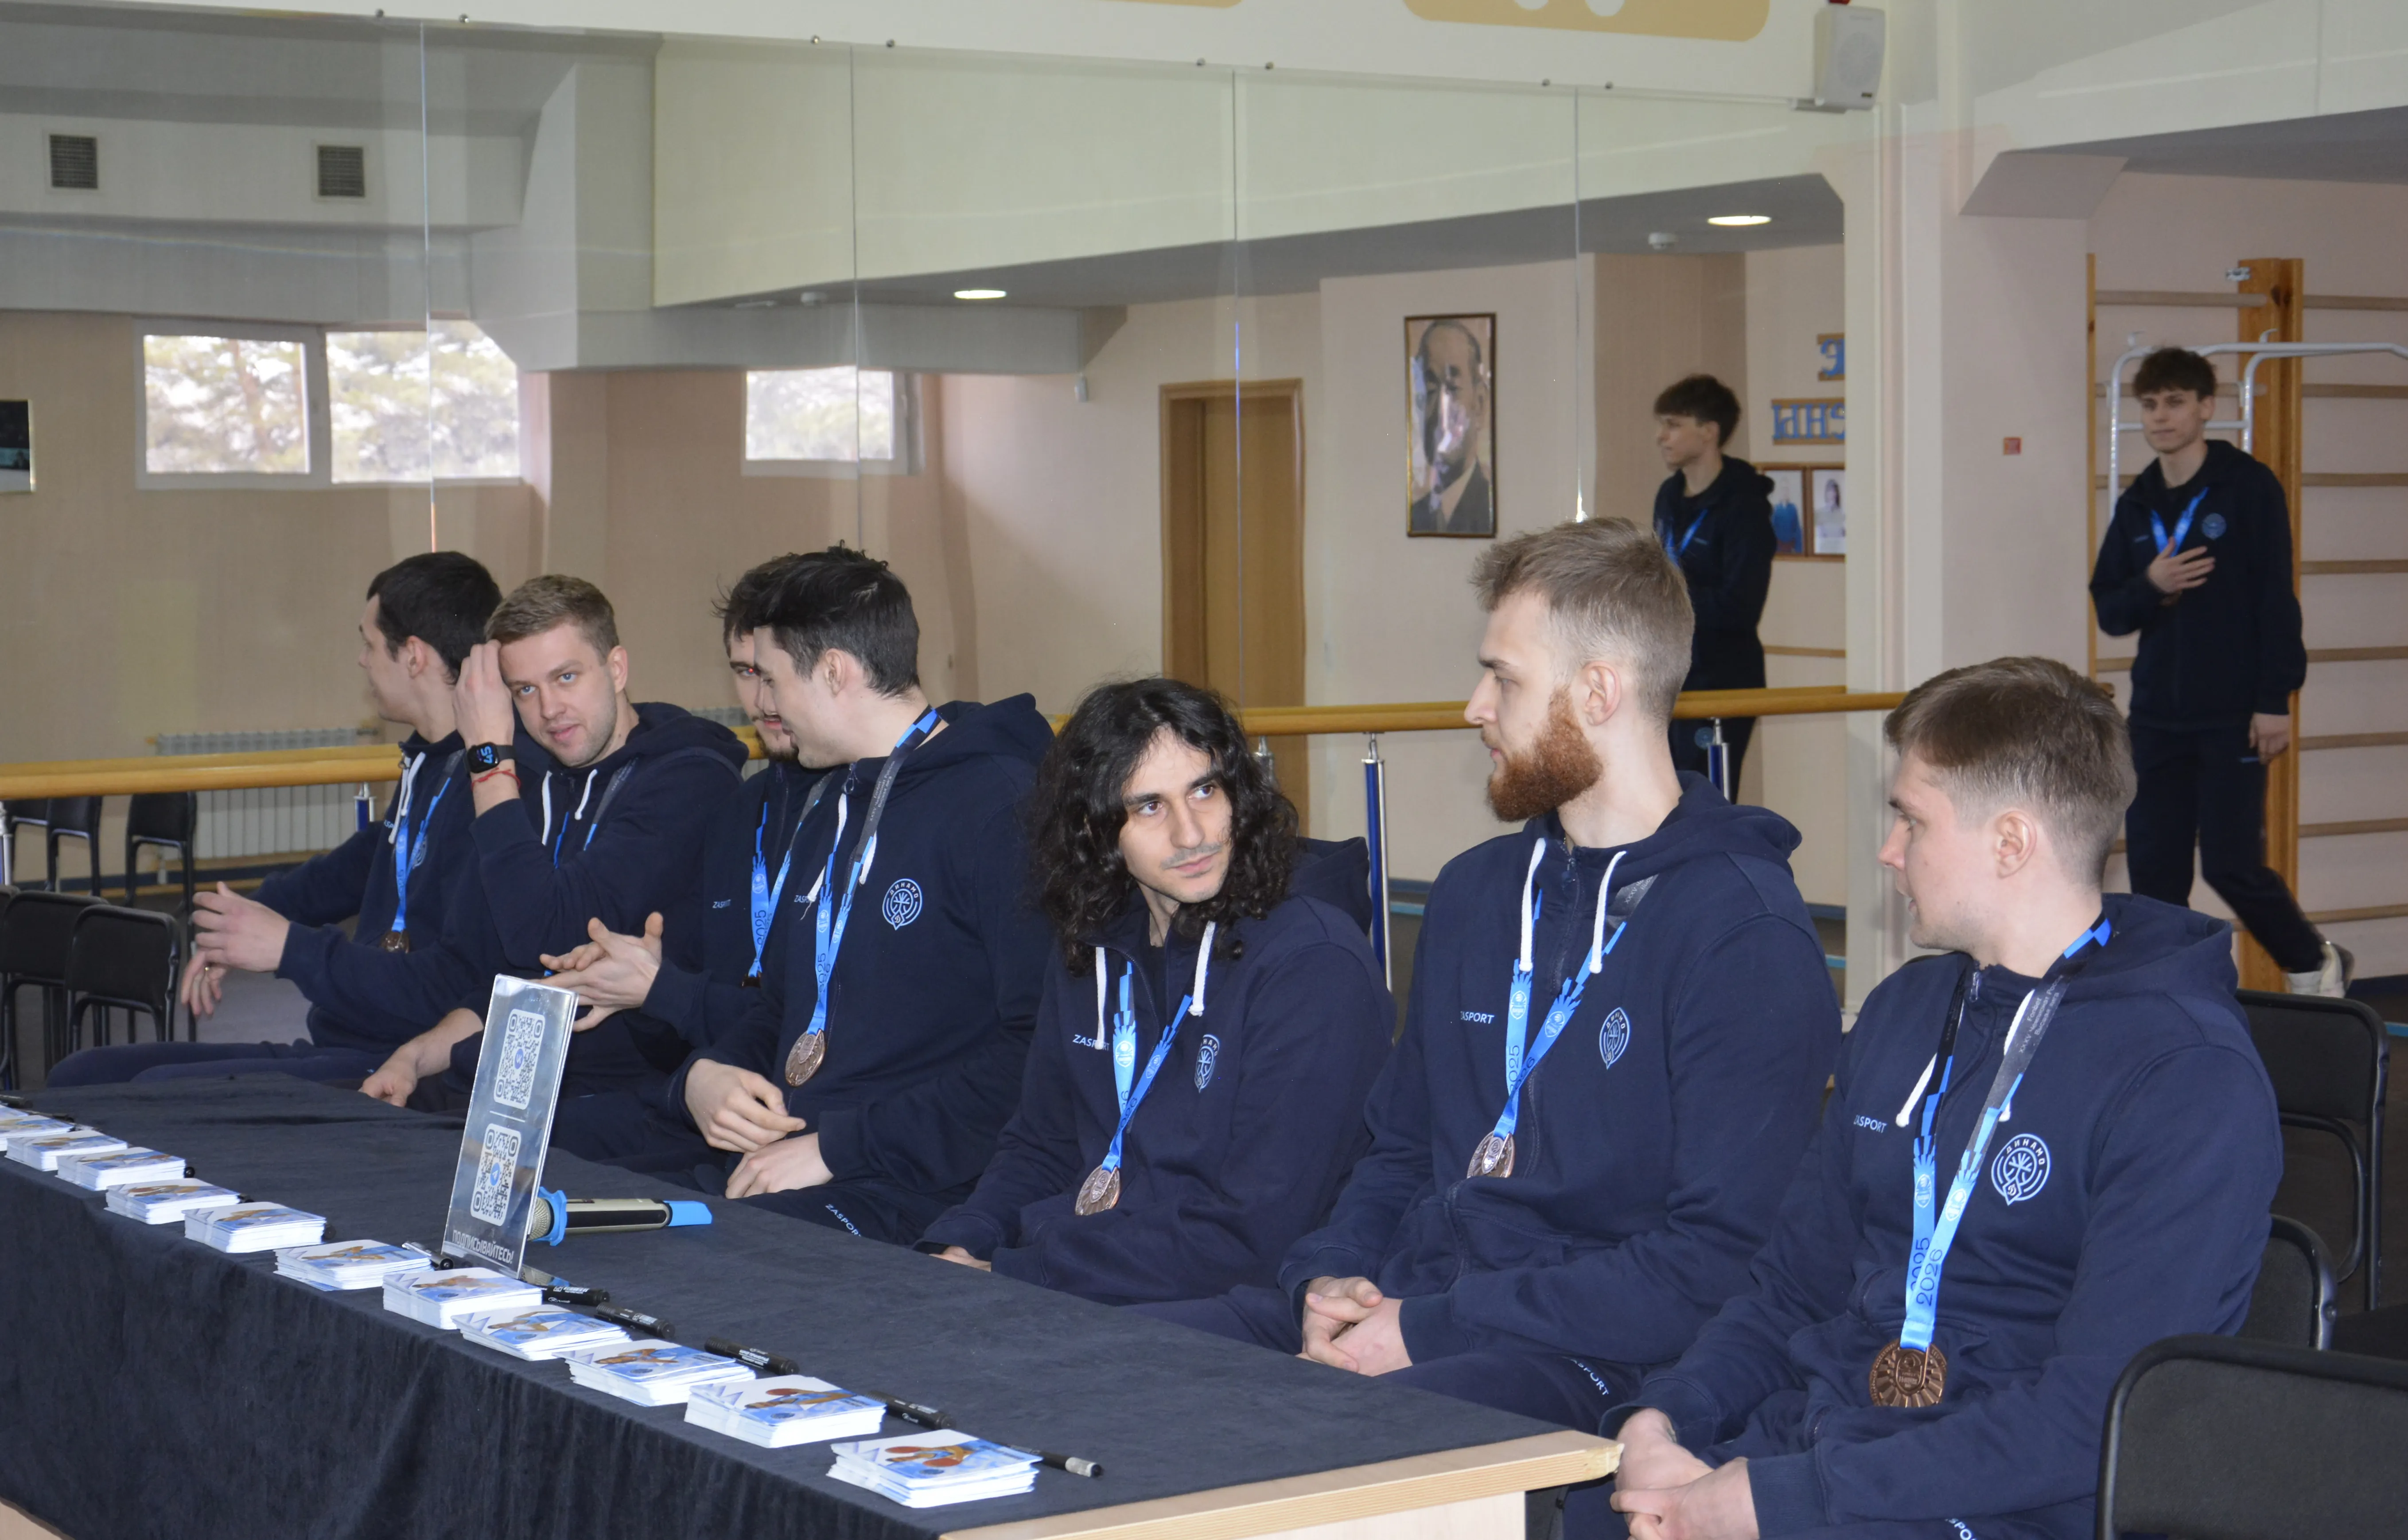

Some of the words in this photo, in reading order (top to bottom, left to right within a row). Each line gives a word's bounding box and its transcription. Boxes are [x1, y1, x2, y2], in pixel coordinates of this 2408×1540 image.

[890, 882, 919, 898] ДИНАМО
[1072, 1034, 1110, 1052] ZASPRT
[1203, 1038, 1218, 1057] НАМО
[2006, 1138, 2046, 1165] ДИНАМО
[825, 1204, 861, 1237] ZASPOR
[452, 1229, 514, 1264] ПОДПИСЫВАЙТЕСЬ!
[1916, 1249, 1943, 1307] 2026
